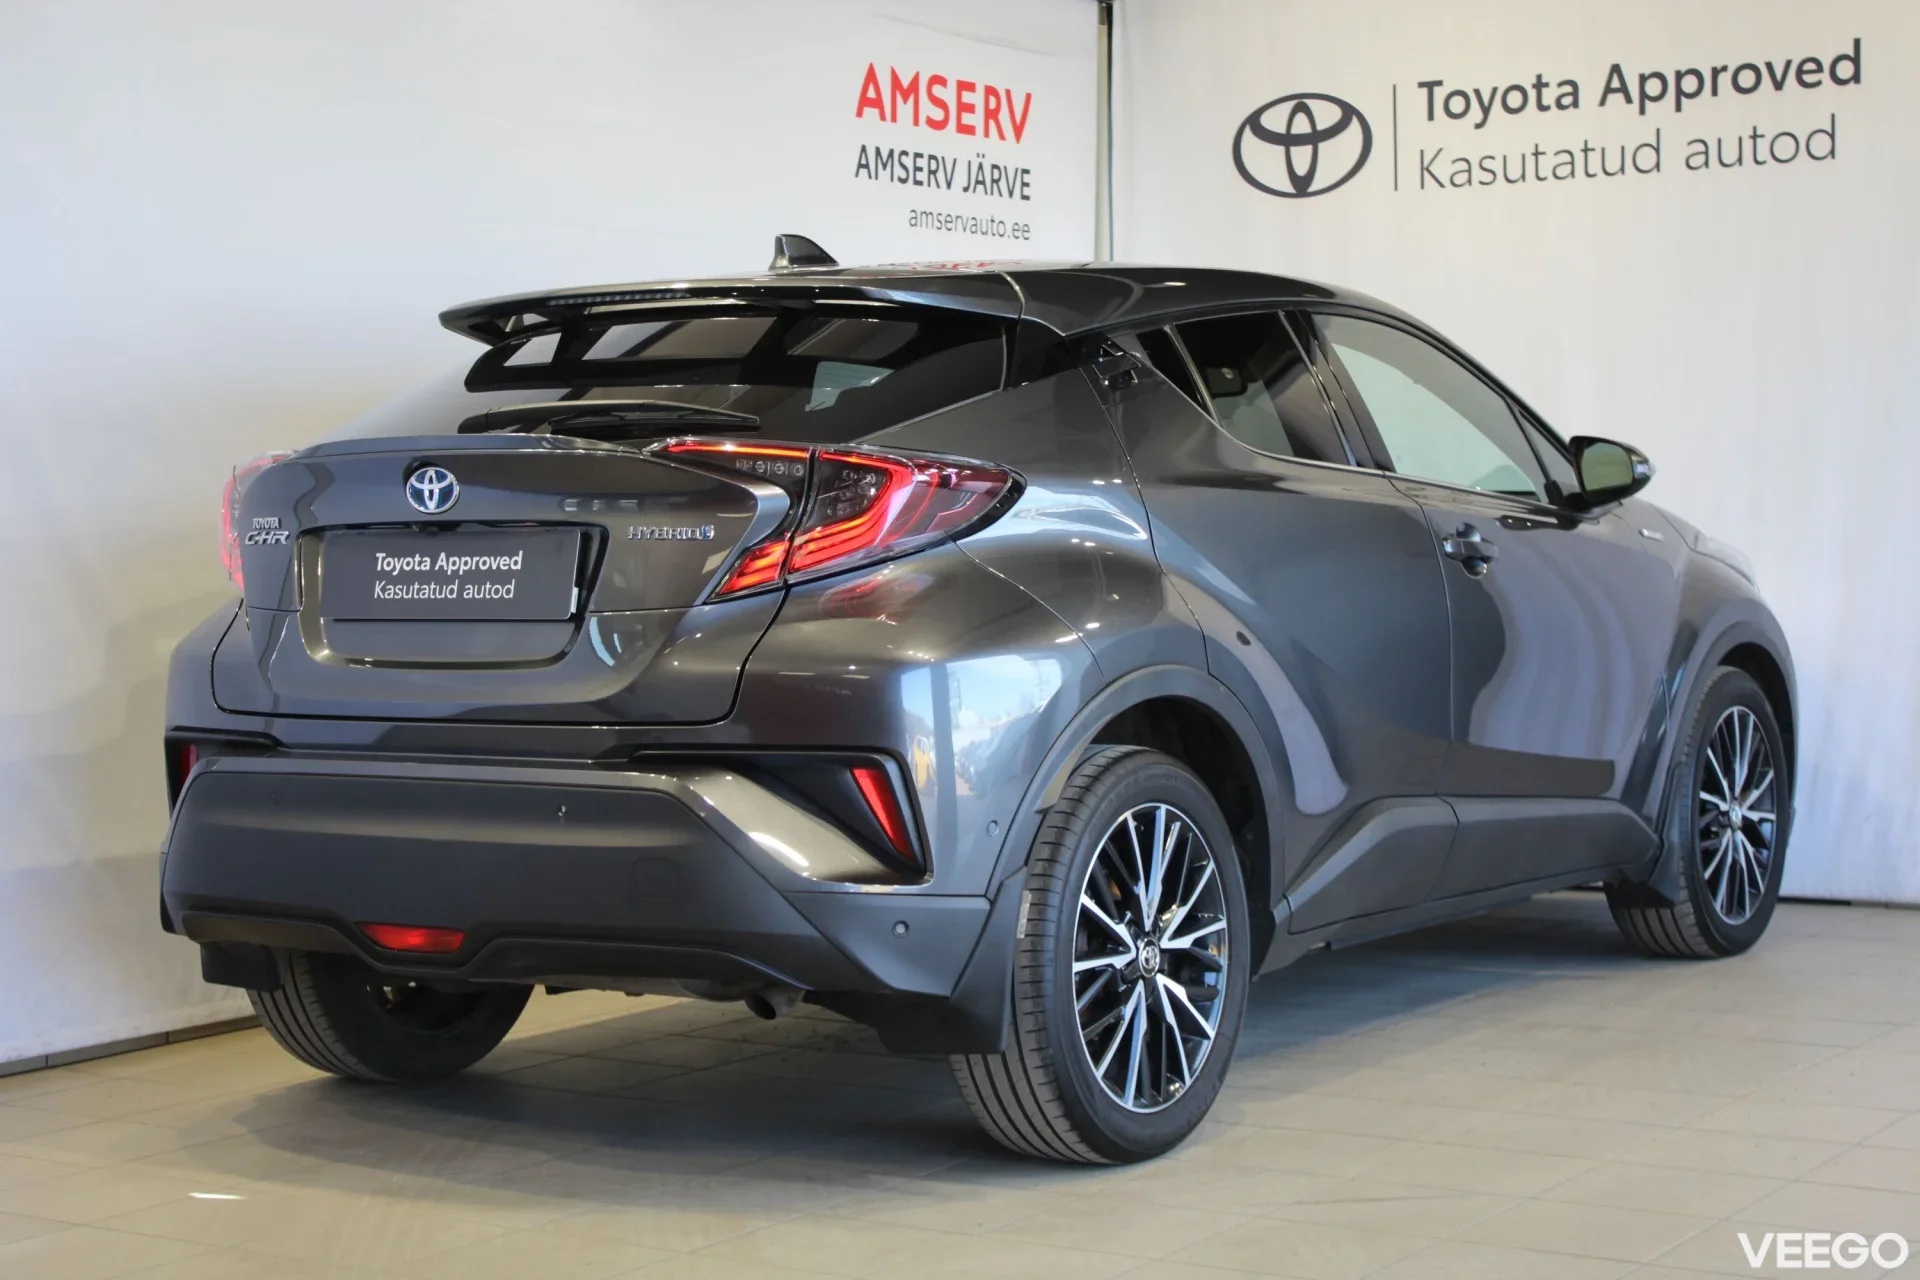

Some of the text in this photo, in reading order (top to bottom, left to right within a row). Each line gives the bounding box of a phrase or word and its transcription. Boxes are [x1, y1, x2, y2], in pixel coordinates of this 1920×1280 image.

[1417, 37, 1863, 130] Toyota Approved
[855, 61, 1033, 145] AMSERV
[1418, 113, 1837, 190] Kasutatud autod
[855, 144, 1032, 201] AMSERV JÄRVE
[908, 208, 1032, 241] amservauto.ee
[252, 517, 280, 529] TOYOTA
[627, 526, 703, 540] HYBRID
[375, 550, 524, 576] Toyota Approved
[374, 578, 516, 599] Kasutatud autod
